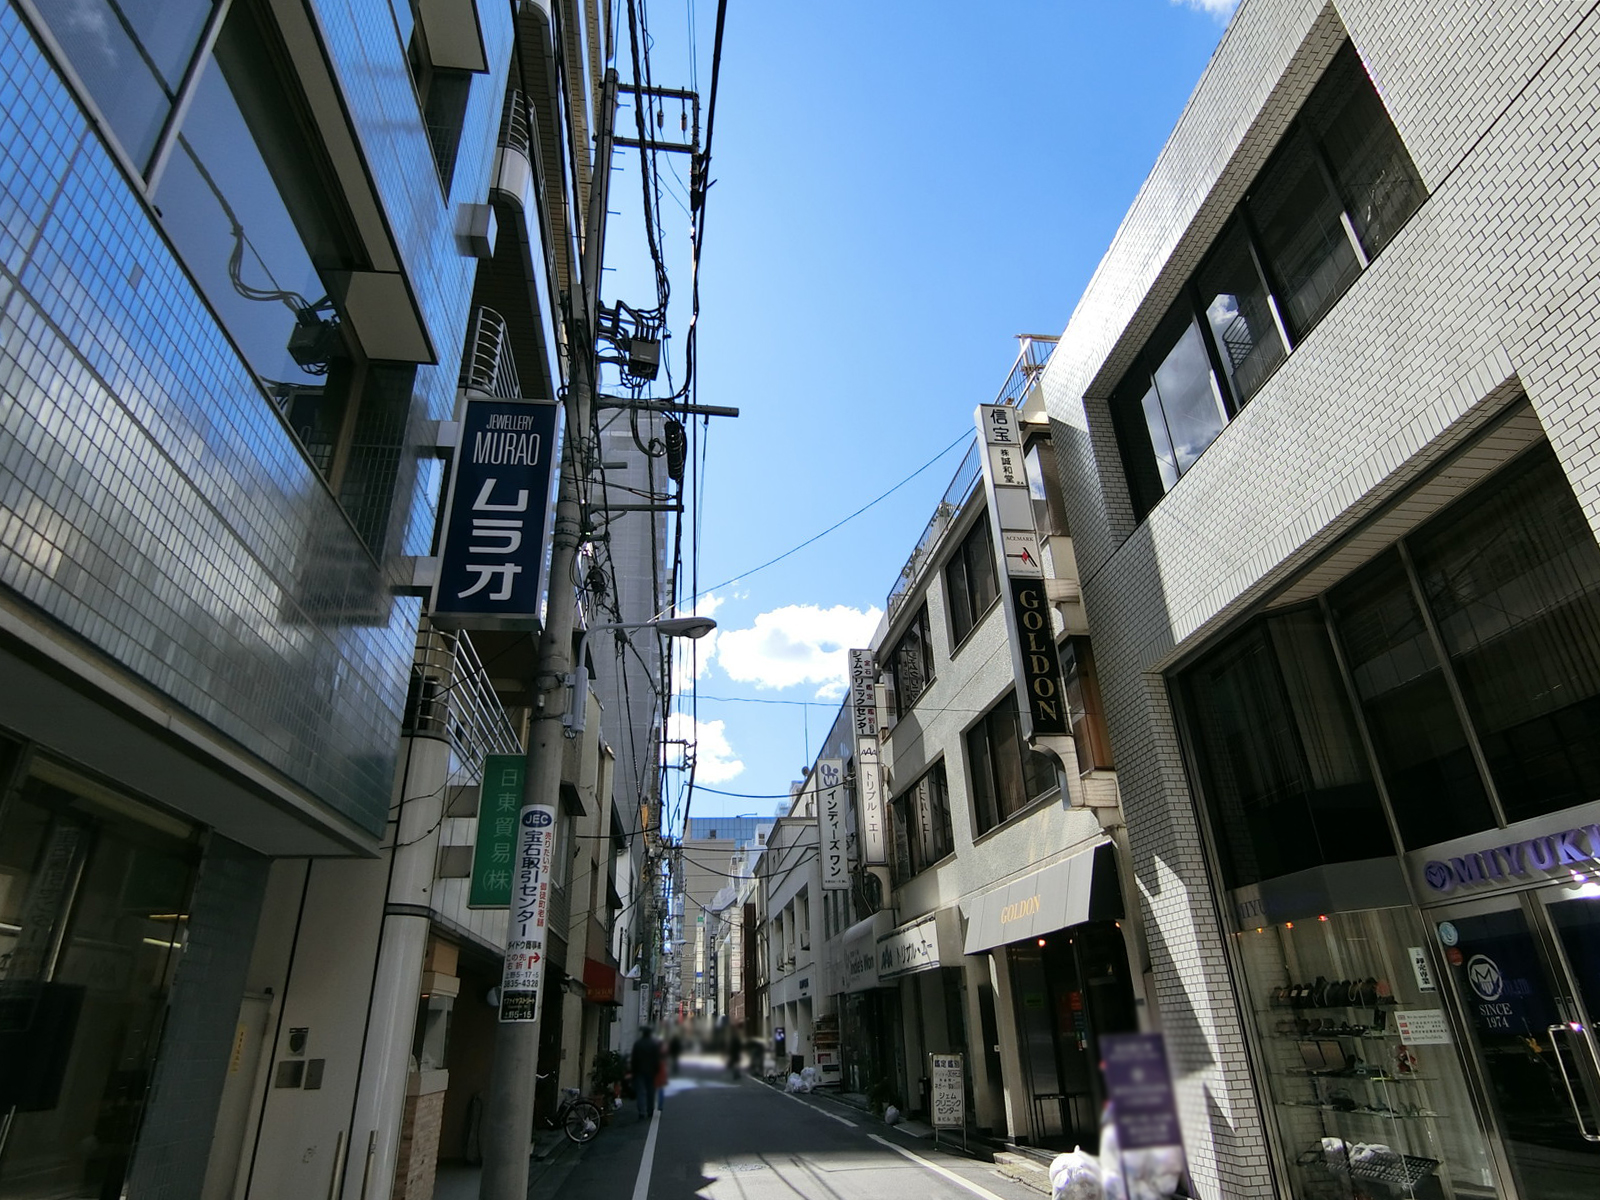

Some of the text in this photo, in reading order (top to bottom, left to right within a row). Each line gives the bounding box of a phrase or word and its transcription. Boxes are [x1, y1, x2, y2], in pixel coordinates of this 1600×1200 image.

[486, 413, 534, 431] JEWELLERY
[472, 431, 540, 466] MURAO
[457, 478, 529, 600] ムラオ
[1019, 589, 1058, 721] GOLDON
[517, 829, 544, 937] 宝石取引センター
[1000, 894, 1041, 924] GOLDON
[1479, 1002, 1514, 1016] SINCE
[1486, 1016, 1511, 1029] 1974
